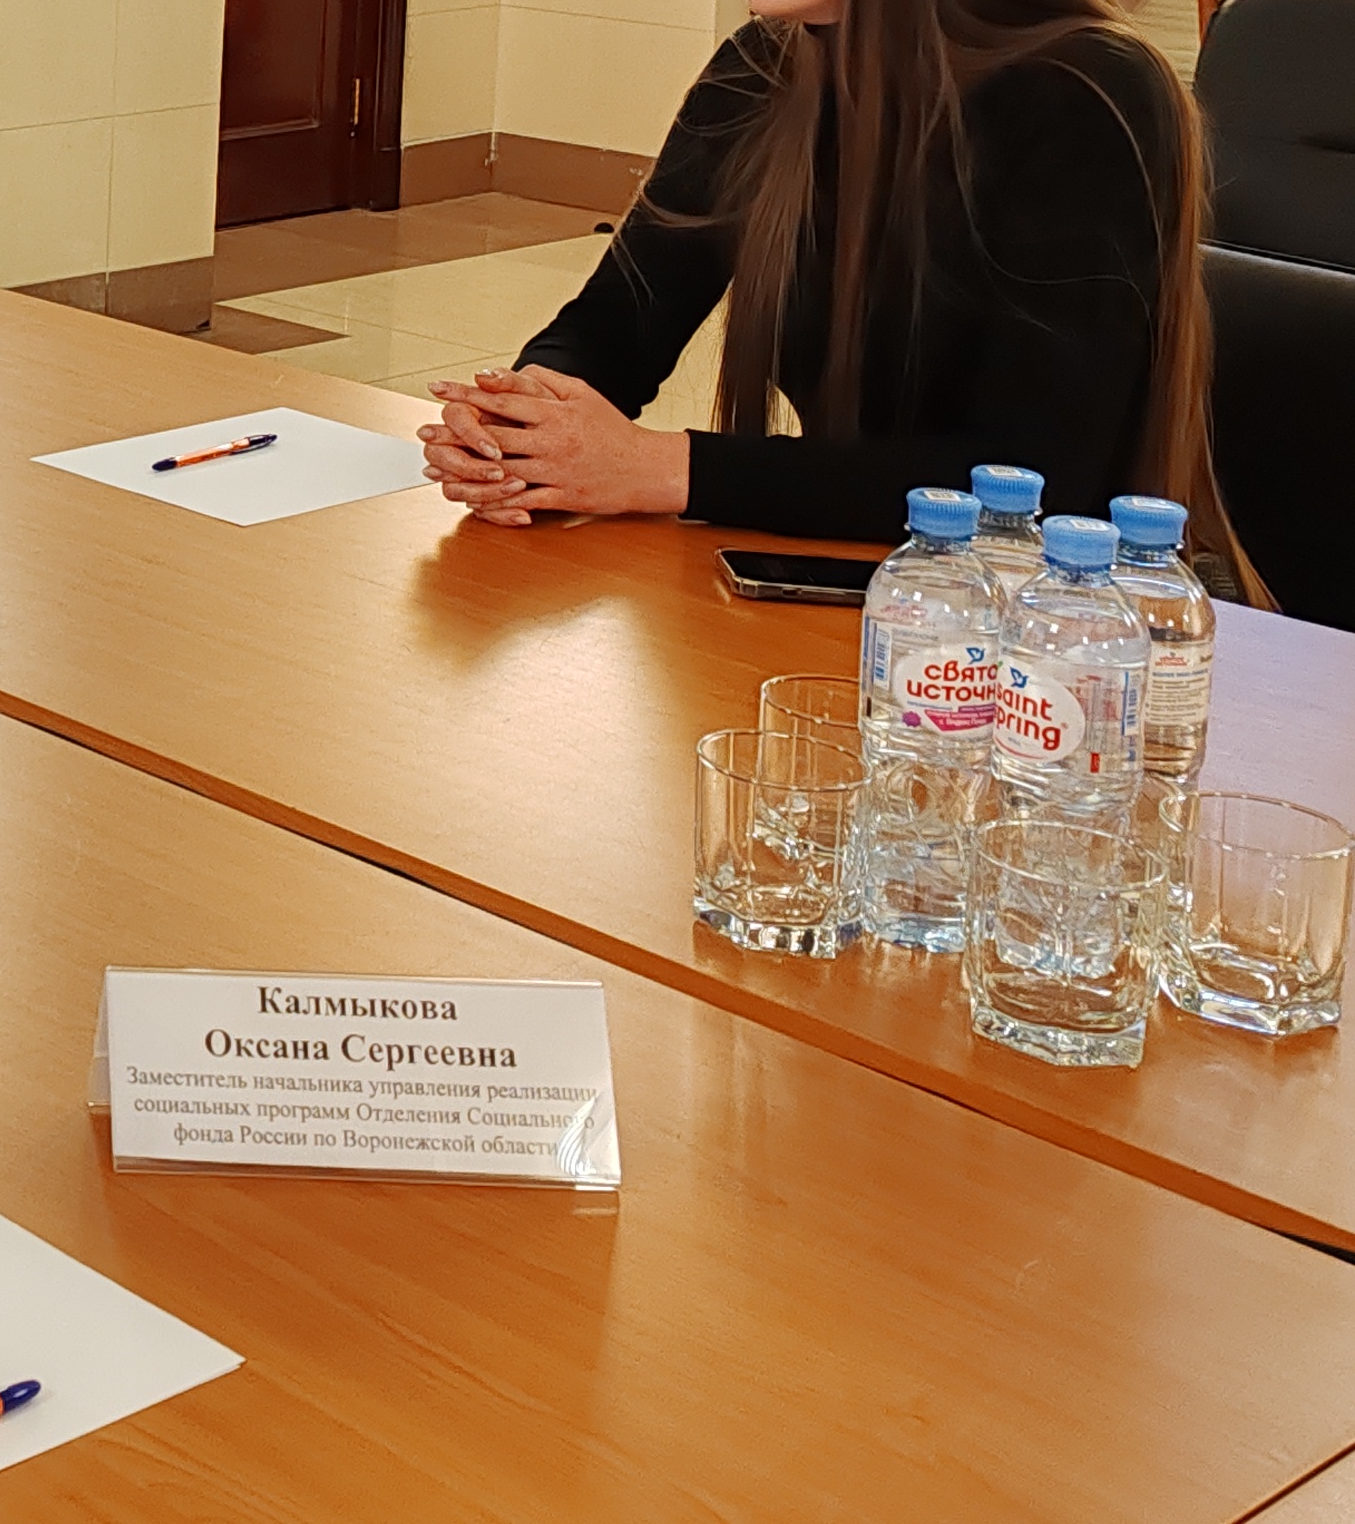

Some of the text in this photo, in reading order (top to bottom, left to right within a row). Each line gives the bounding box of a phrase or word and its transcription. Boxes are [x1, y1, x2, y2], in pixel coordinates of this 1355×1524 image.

[258, 986, 458, 1021] Калмыкова
[204, 1028, 517, 1071] Оксана Сергеевна
[126, 1066, 247, 1090] Заместитель
[253, 1074, 363, 1094] начальника
[369, 1079, 480, 1100] управления
[134, 1097, 461, 1125] социальных программ Отделения
[174, 1124, 559, 1156] фонда России по Воронежской области
